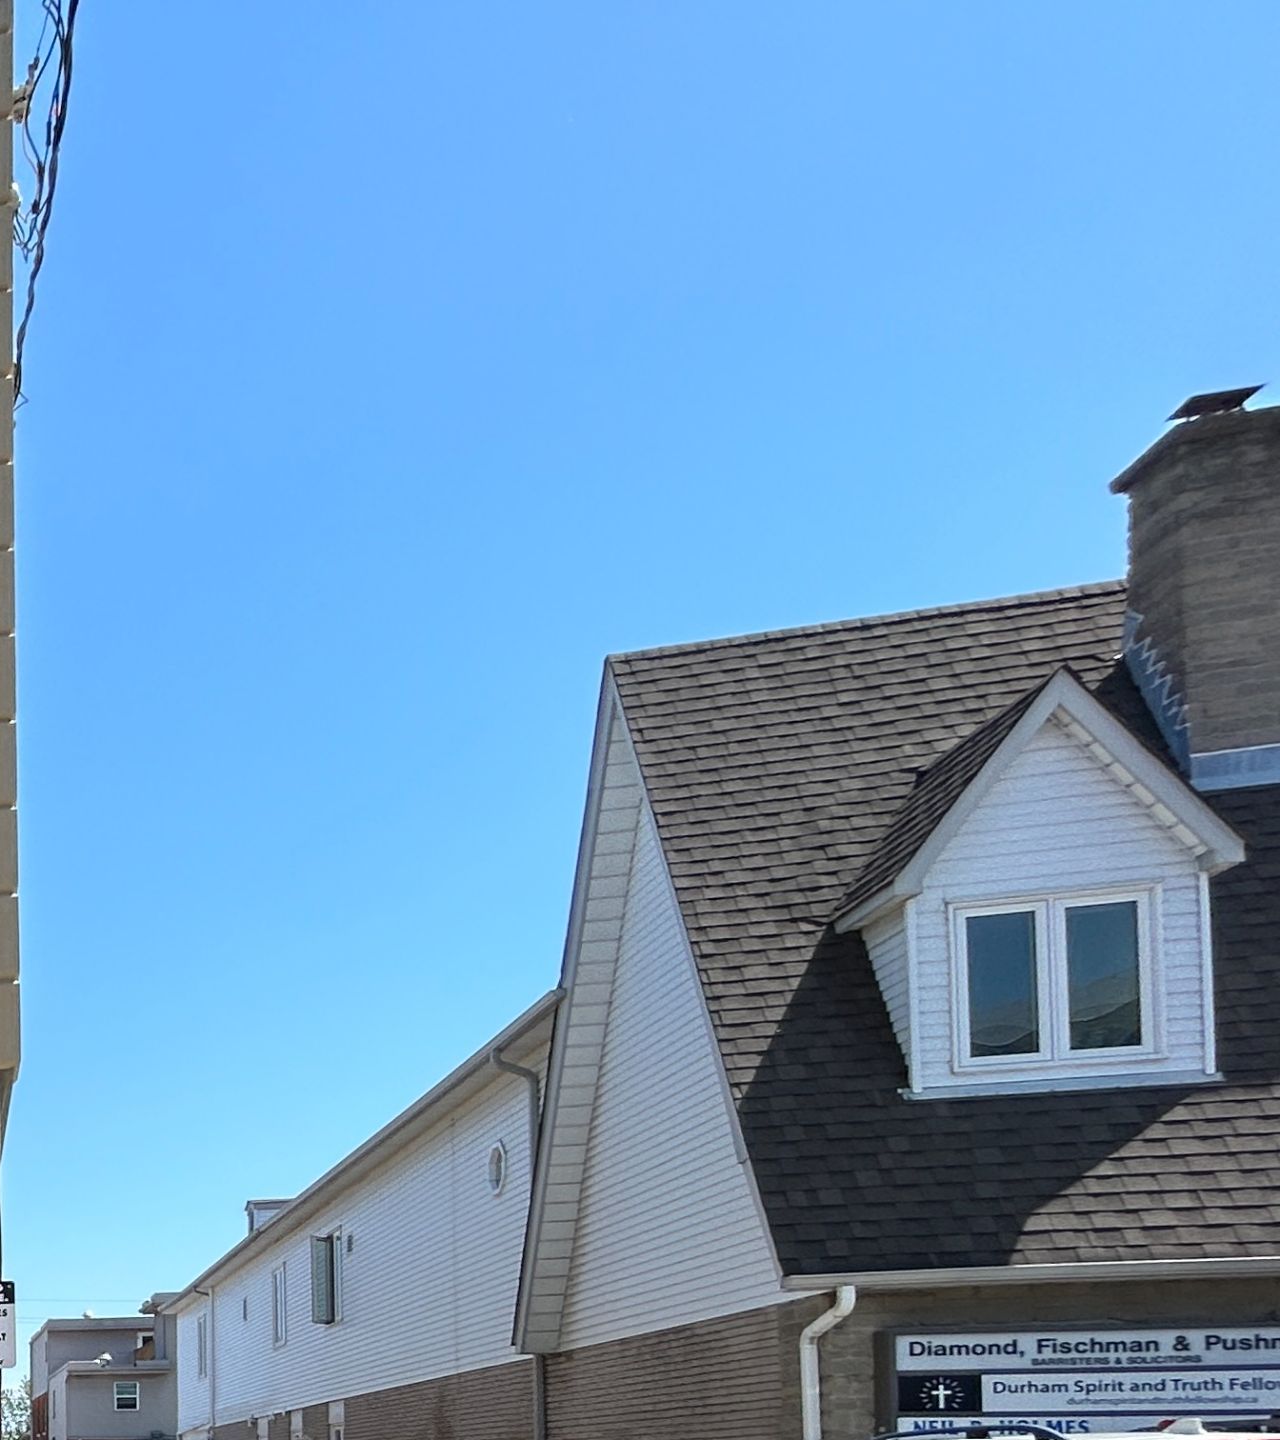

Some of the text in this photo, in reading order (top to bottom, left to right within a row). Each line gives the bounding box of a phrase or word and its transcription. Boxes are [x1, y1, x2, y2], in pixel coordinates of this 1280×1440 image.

[909, 1339, 1025, 1357] Diamond,
[1037, 1337, 1160, 1354] Fischman
[1172, 1335, 1190, 1352] &
[1031, 1355, 1203, 1366] BARRISTERS & SOLICITORS
[993, 1380, 1068, 1394] Durham
[1073, 1380, 1124, 1395] Spirit
[1129, 1378, 1166, 1392] and
[1169, 1377, 1223, 1392] Truth
